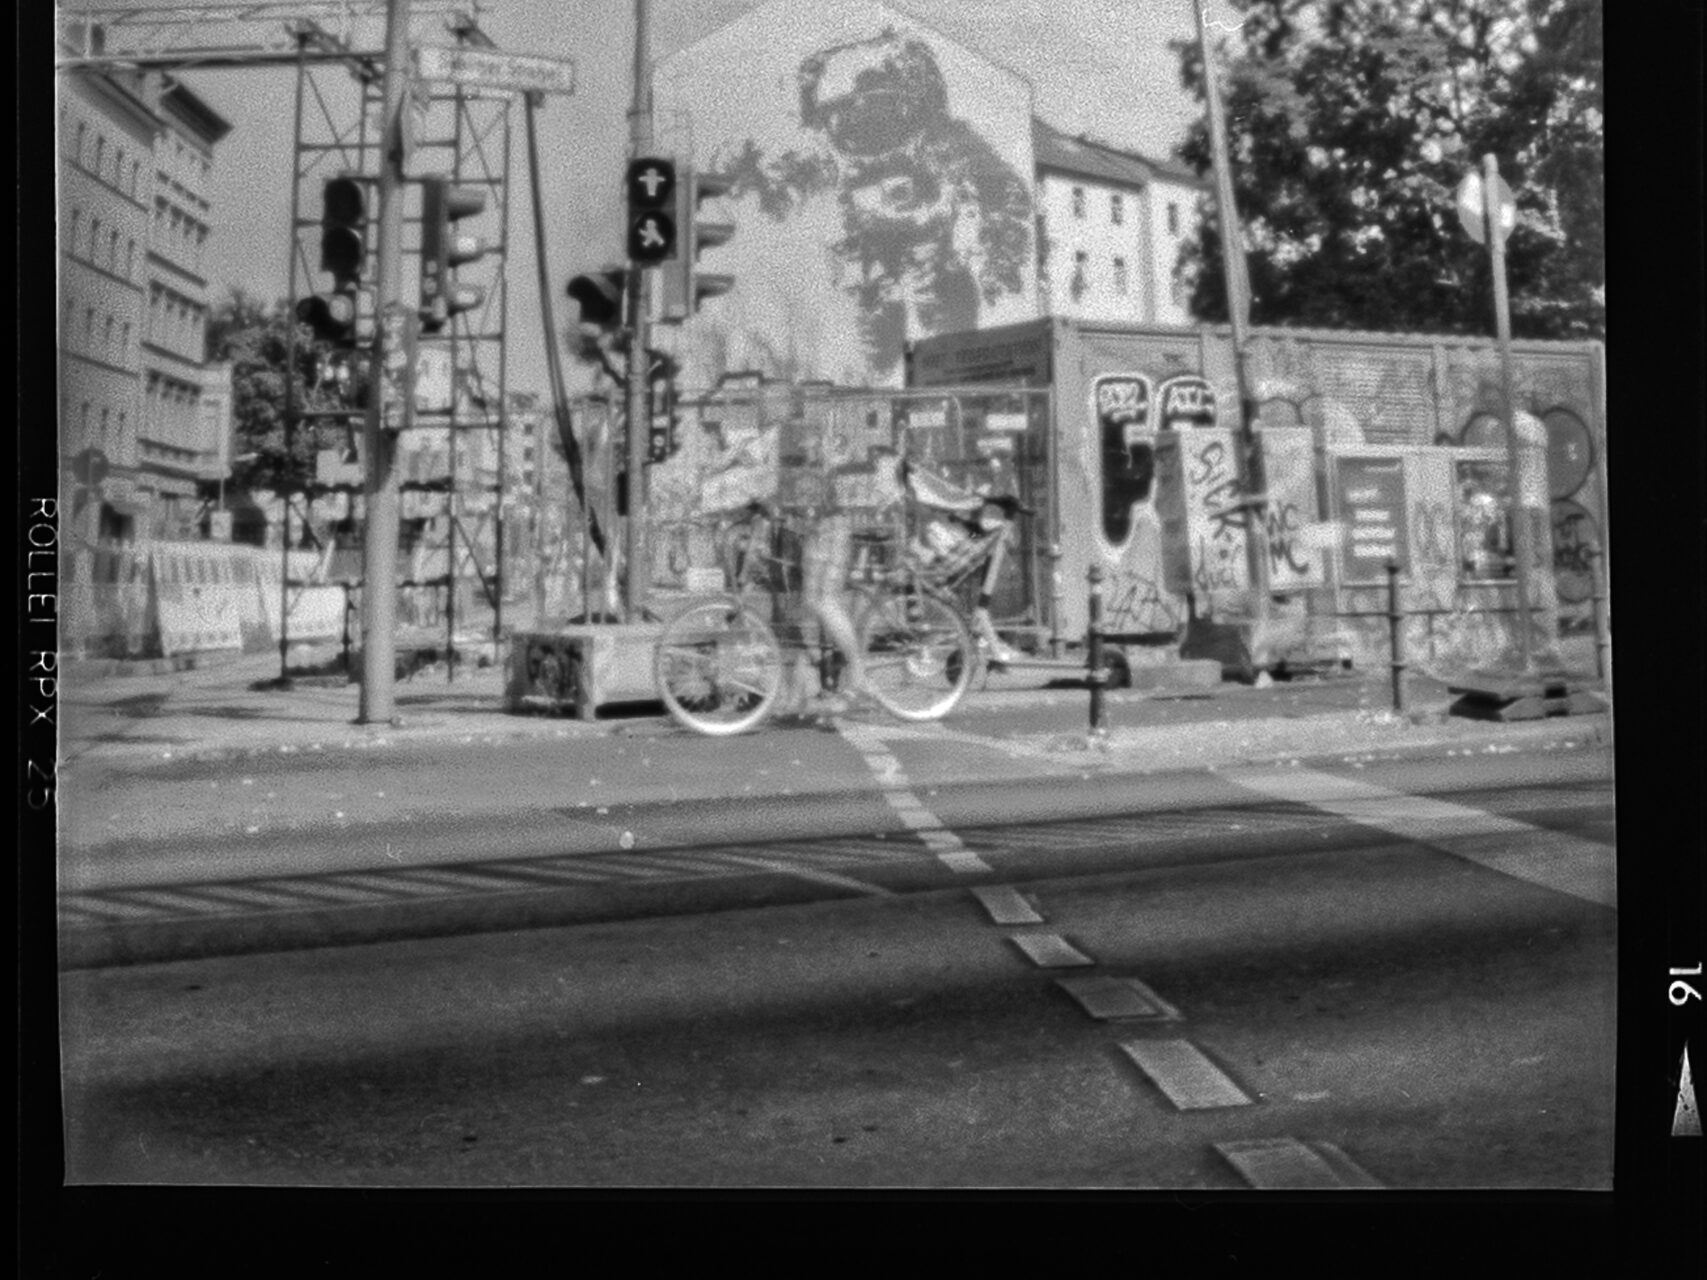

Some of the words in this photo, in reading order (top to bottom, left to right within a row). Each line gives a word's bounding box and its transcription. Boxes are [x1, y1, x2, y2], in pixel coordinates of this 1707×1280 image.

[28, 497, 58, 623] ROLLEI
[29, 650, 58, 725] RPX
[27, 758, 56, 810] 25
[1668, 961, 1702, 1006] 16
